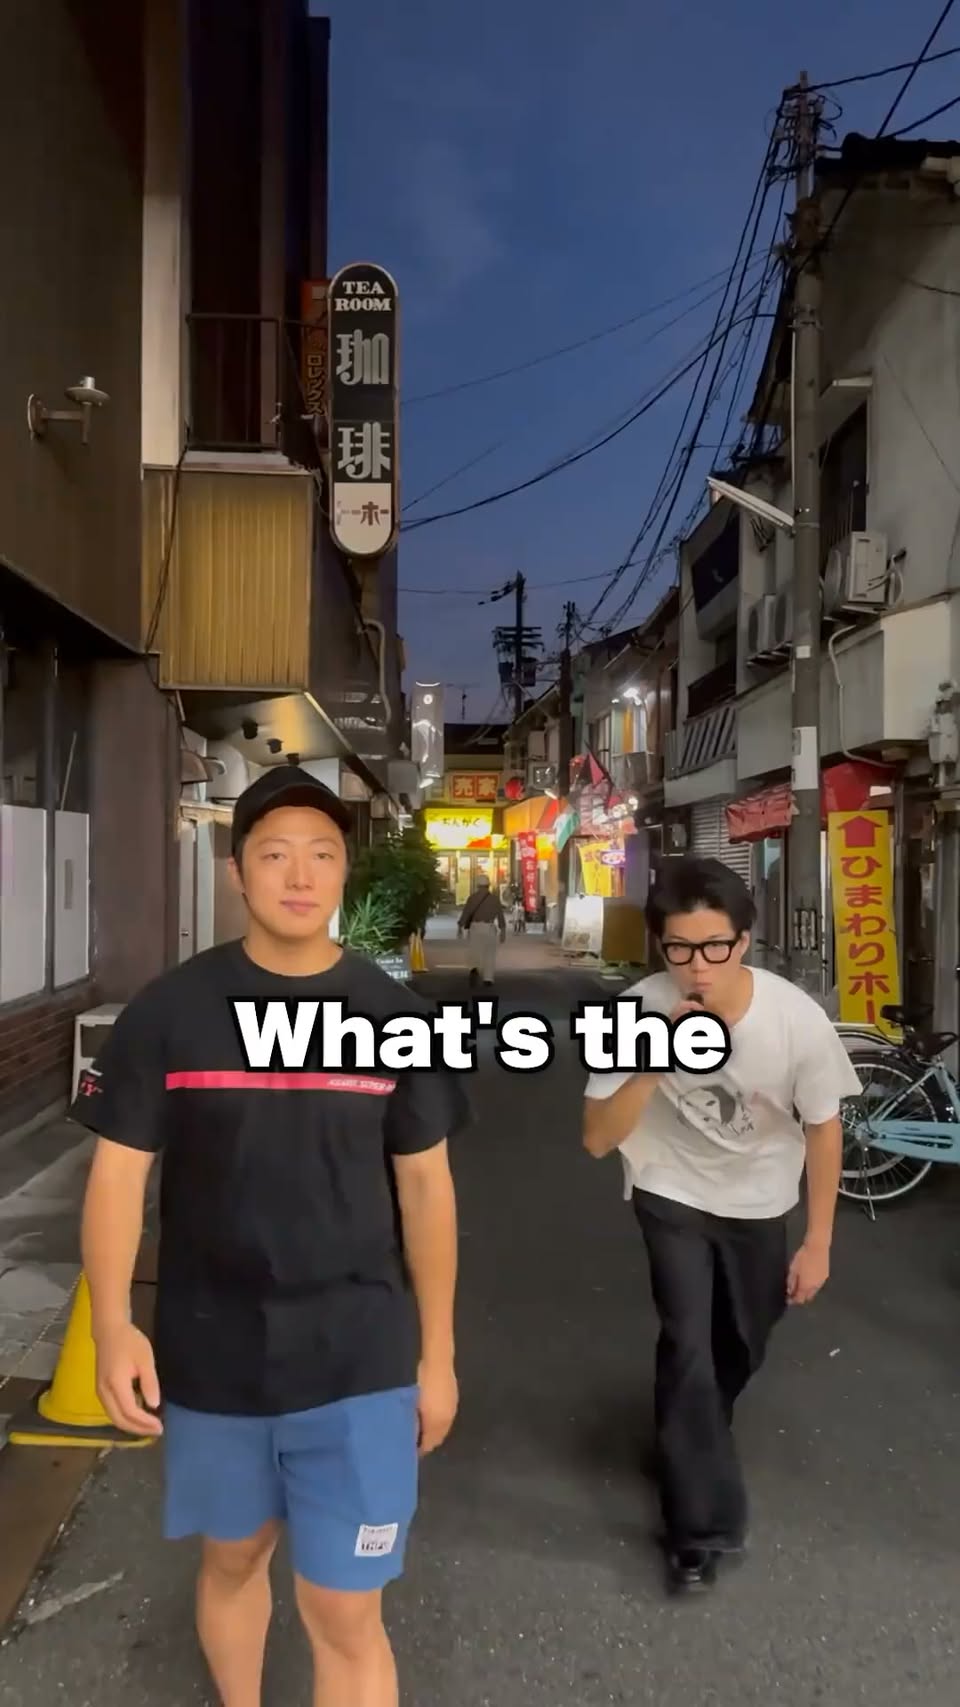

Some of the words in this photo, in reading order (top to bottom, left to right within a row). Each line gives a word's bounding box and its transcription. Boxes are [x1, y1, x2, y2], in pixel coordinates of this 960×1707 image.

[334, 298, 392, 312] ROOM
[342, 281, 385, 295] TEA
[306, 353, 324, 416] ロレックス
[336, 328, 391, 480] 珈琲
